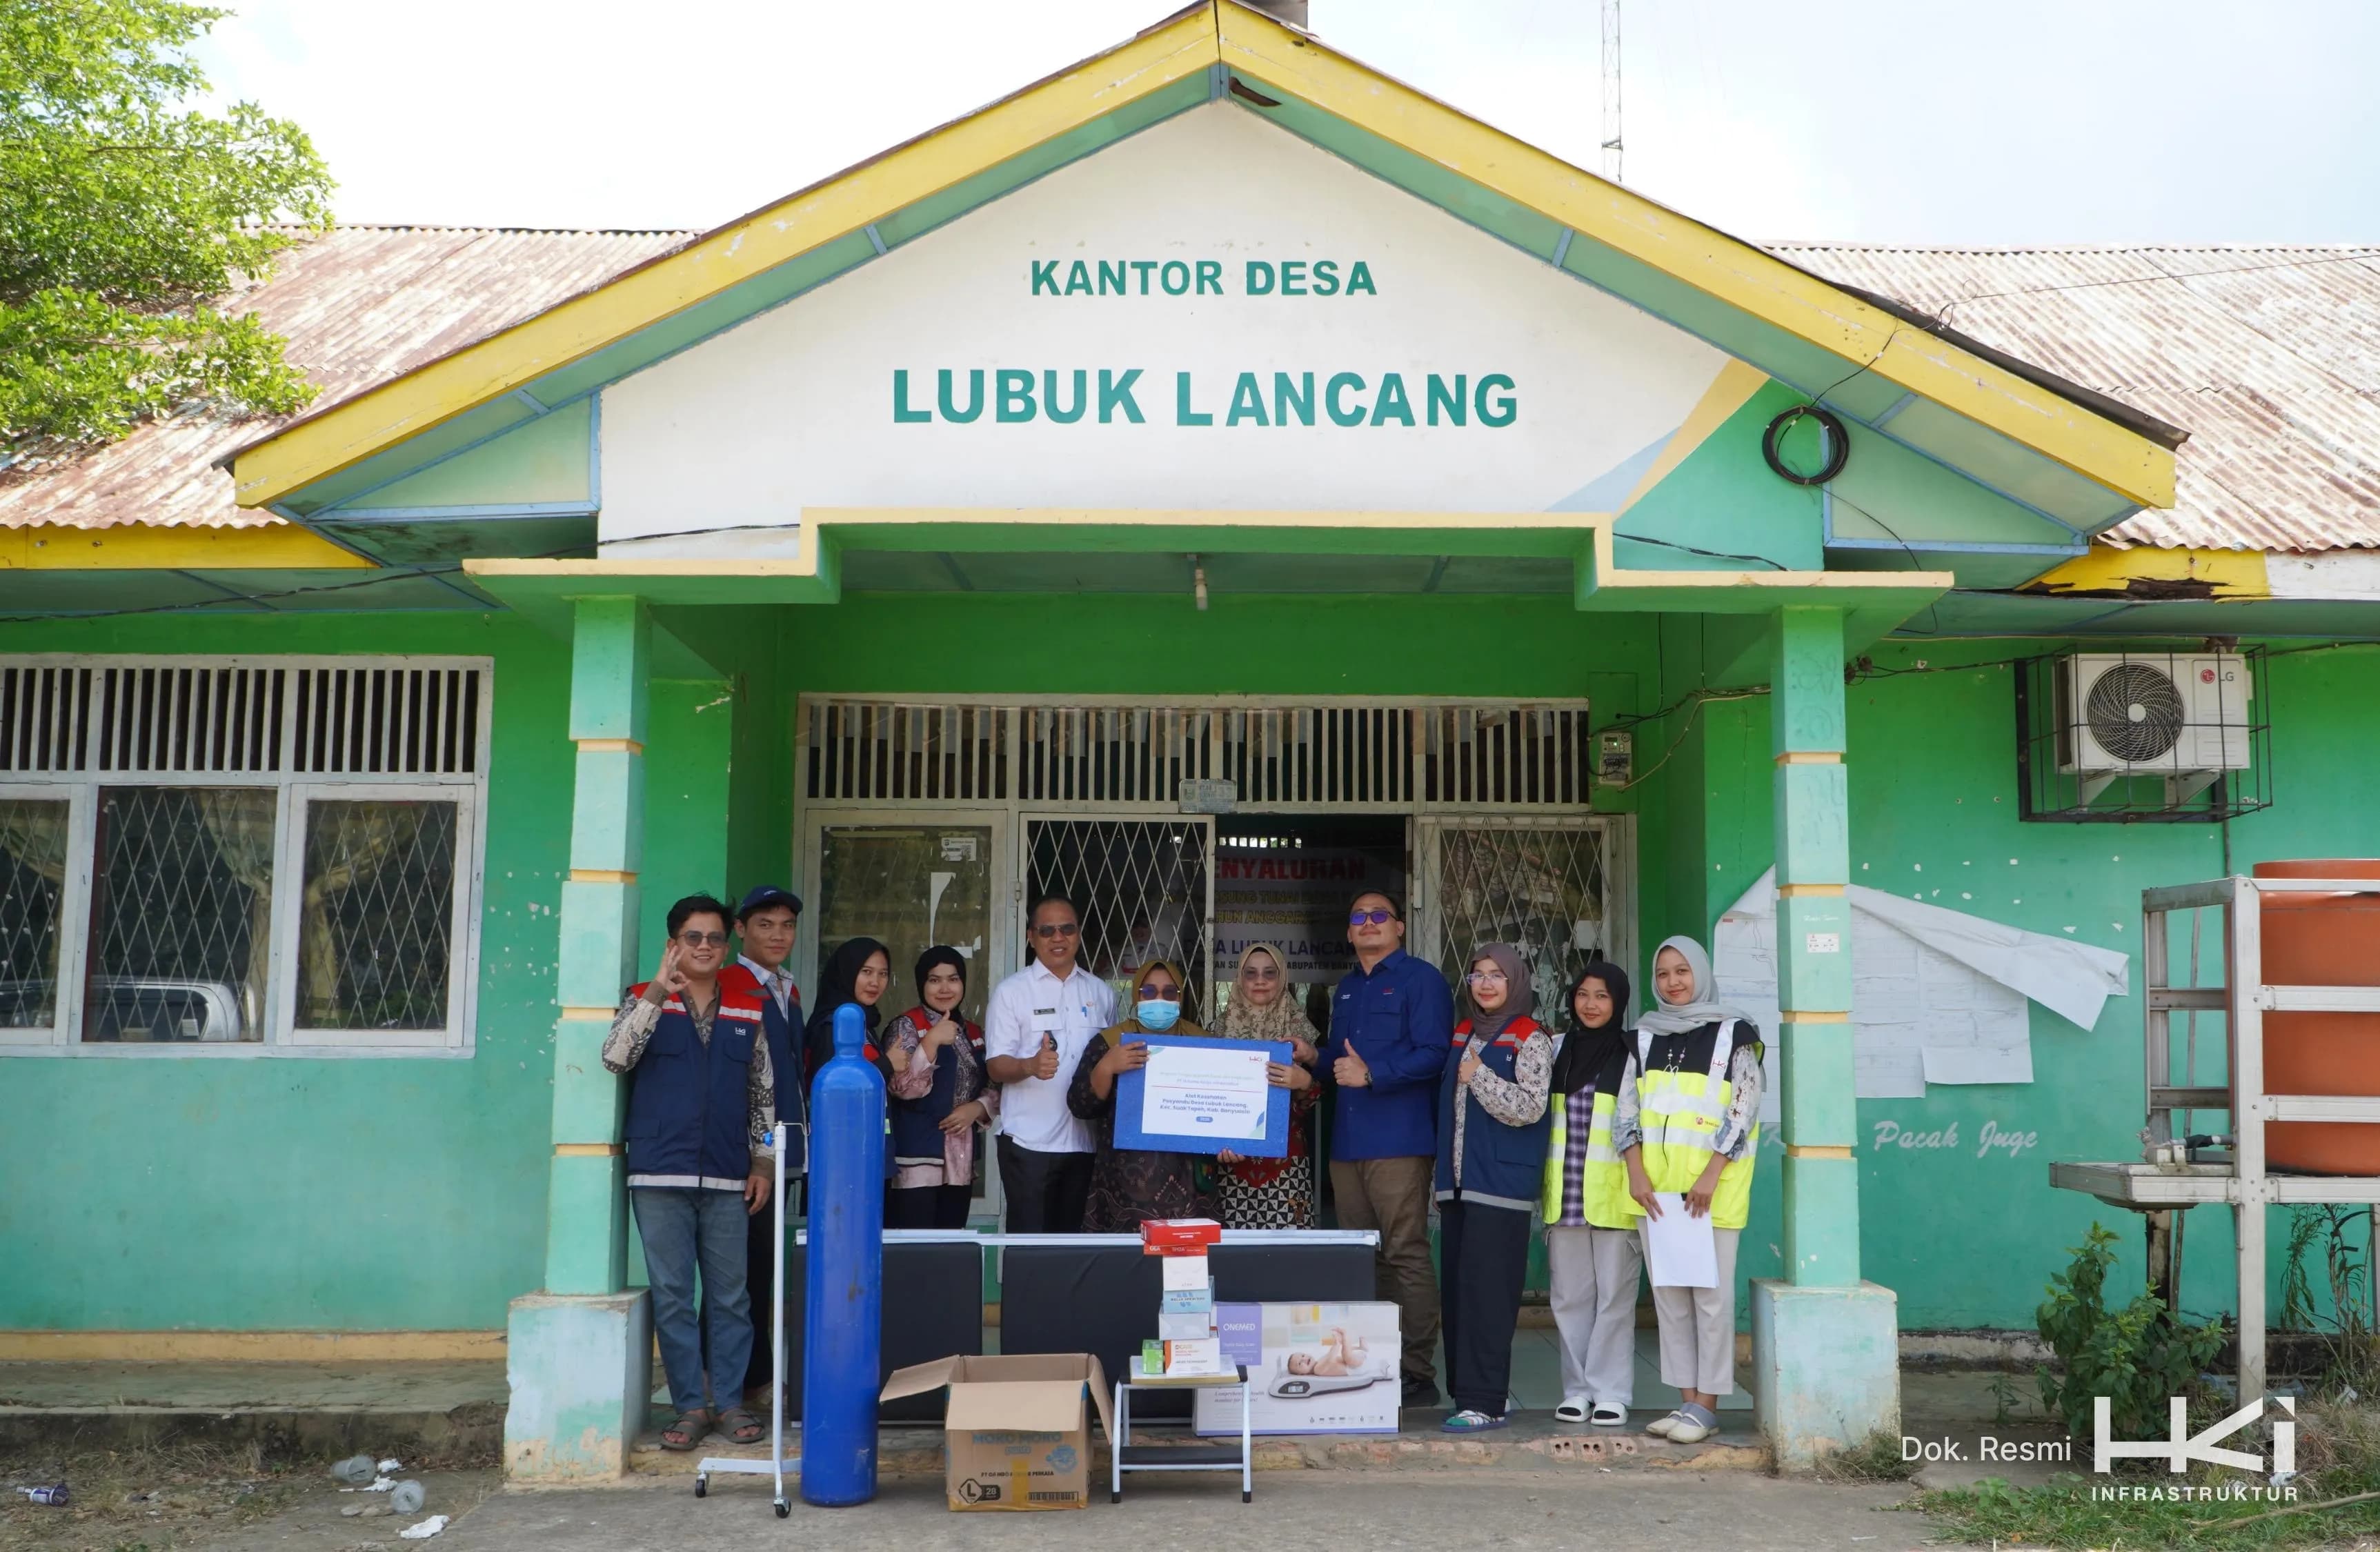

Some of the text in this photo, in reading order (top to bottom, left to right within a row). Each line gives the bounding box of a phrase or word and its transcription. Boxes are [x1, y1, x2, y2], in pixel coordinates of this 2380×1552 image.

[1031, 261, 1378, 296] KANTOR DESA
[893, 369, 1518, 428] LUBUK LANCANG
[1214, 857, 1366, 881] ENYALURAN
[1215, 910, 1242, 924] HUN
[1287, 961, 1330, 971] ABUPATEN
[1874, 1120, 2039, 1159] Pacak Juge
[1223, 1323, 1256, 1331] ONEMED
[967, 1483, 977, 1497] L
